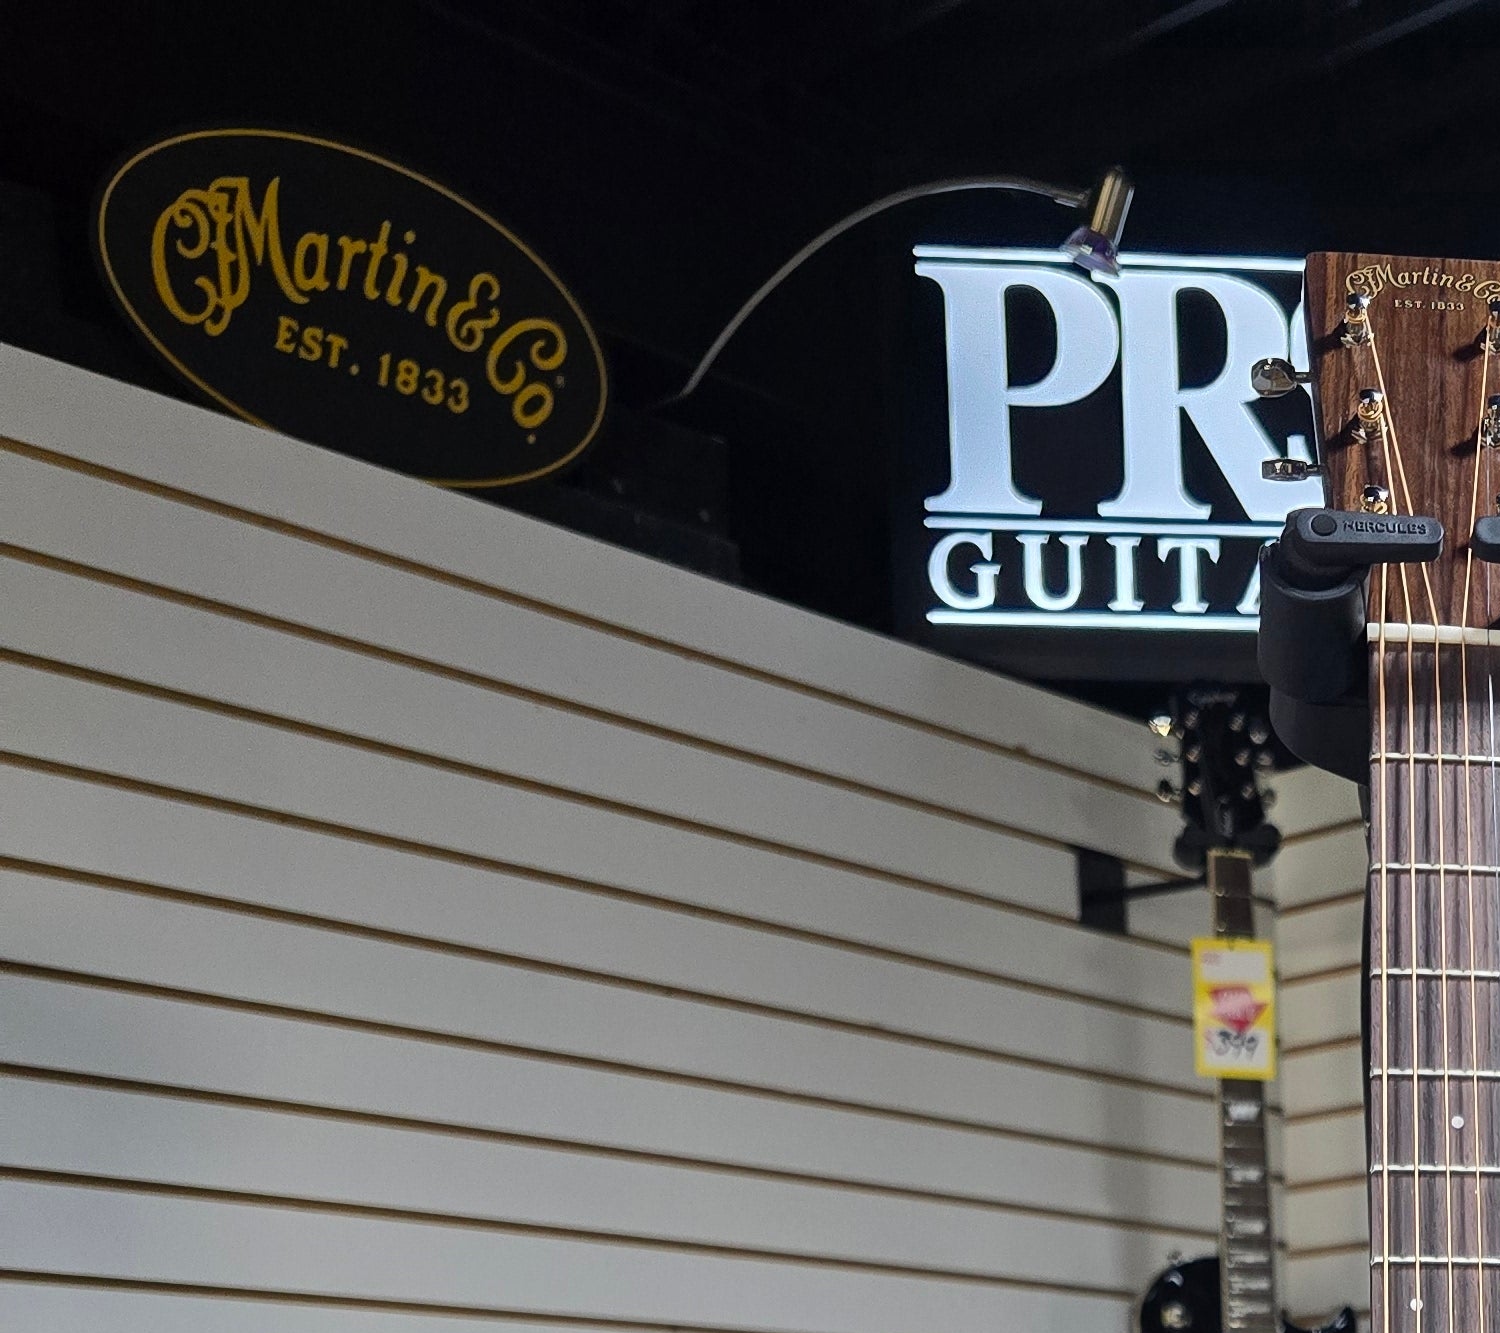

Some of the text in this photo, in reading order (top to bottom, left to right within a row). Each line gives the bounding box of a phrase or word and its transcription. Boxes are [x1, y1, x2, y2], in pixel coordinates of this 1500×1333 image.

[1394, 298, 1466, 312] EST. 1833
[274, 315, 472, 415] EST. 1833
[914, 259, 1326, 522] PR
[1342, 519, 1428, 536] HERCULES
[926, 530, 1262, 615] GUIT
